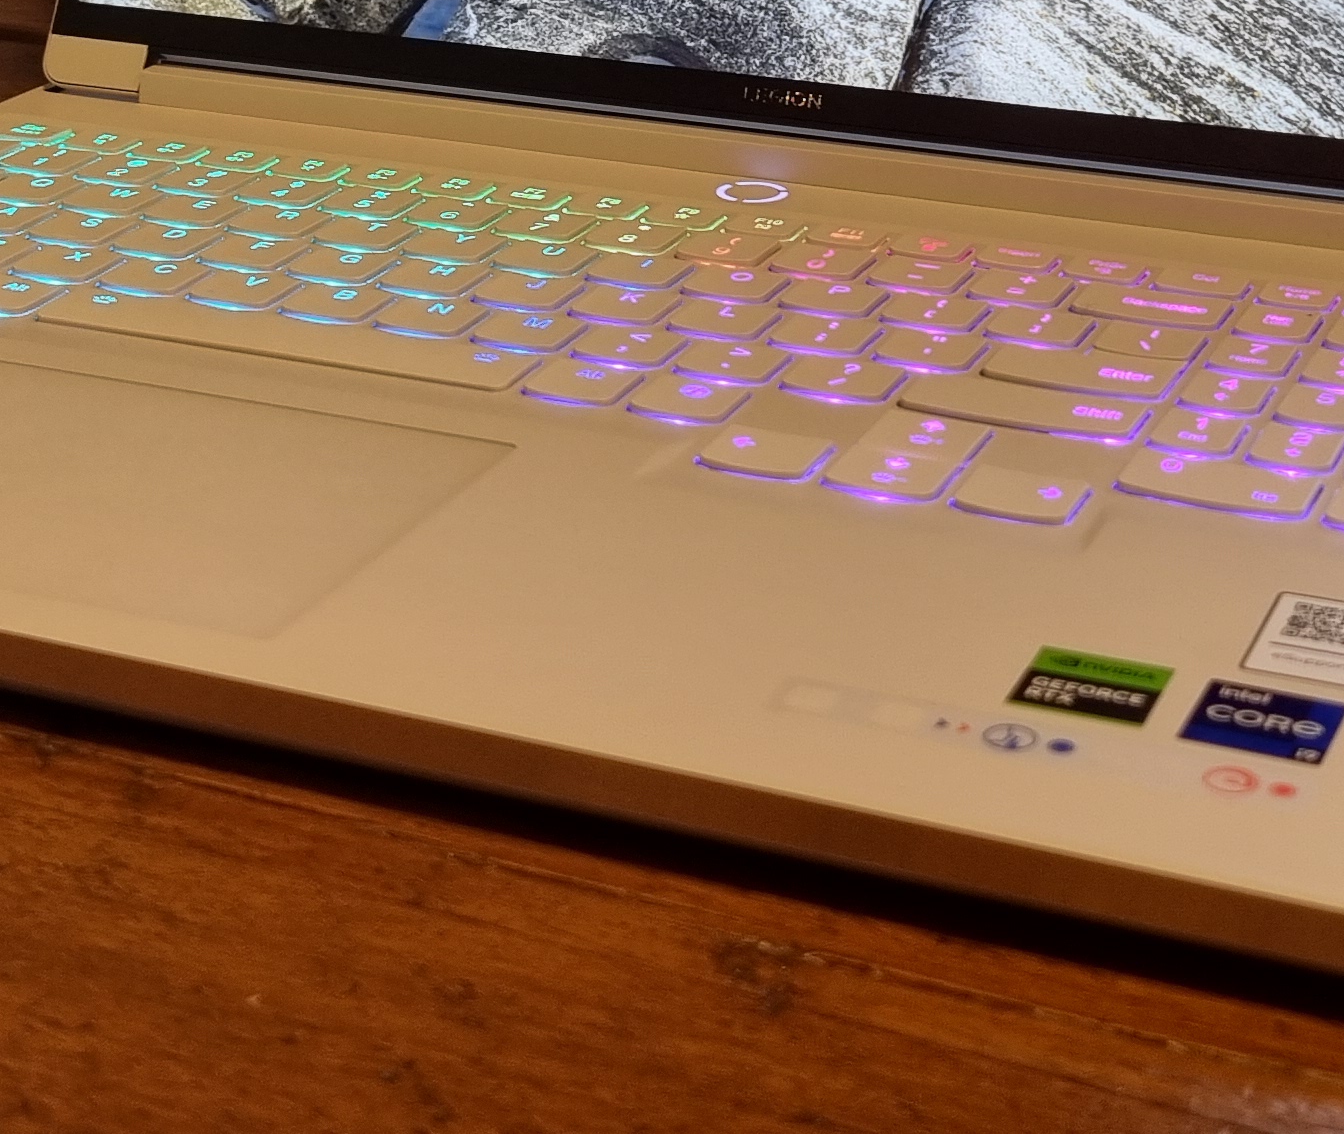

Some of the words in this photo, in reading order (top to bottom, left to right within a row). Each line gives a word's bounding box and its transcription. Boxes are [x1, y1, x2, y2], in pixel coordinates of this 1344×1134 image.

[743, 86, 823, 110] LEGION
[109, 188, 140, 199] W
[192, 200, 217, 210] E
[275, 210, 301, 221] R
[440, 211, 460, 220] 6
[80, 217, 104, 228] S
[367, 222, 389, 232] T
[455, 233, 477, 244] Y
[617, 234, 638, 243] 8
[250, 240, 276, 250] F
[542, 245, 567, 256] U
[63, 251, 92, 262] X
[339, 254, 364, 265] G
[154, 263, 178, 274] C
[428, 265, 457, 277] H
[245, 275, 270, 287] V
[525, 279, 548, 290] J
[332, 289, 359, 301] B
[827, 284, 853, 295] P
[618, 291, 646, 304] K
[427, 303, 456, 316] N
[718, 305, 736, 318] L
[522, 316, 554, 330] M
[1249, 343, 1270, 355] 7
[1098, 367, 1154, 382] Enter
[1218, 378, 1240, 391] 4
[1072, 405, 1124, 421] Shift
[1195, 416, 1210, 431] 1
[1288, 431, 1314, 447] 2
[1022, 684, 1076, 707] RTX
[1030, 675, 1149, 708] GEFORCE
[1217, 683, 1274, 706] intel
